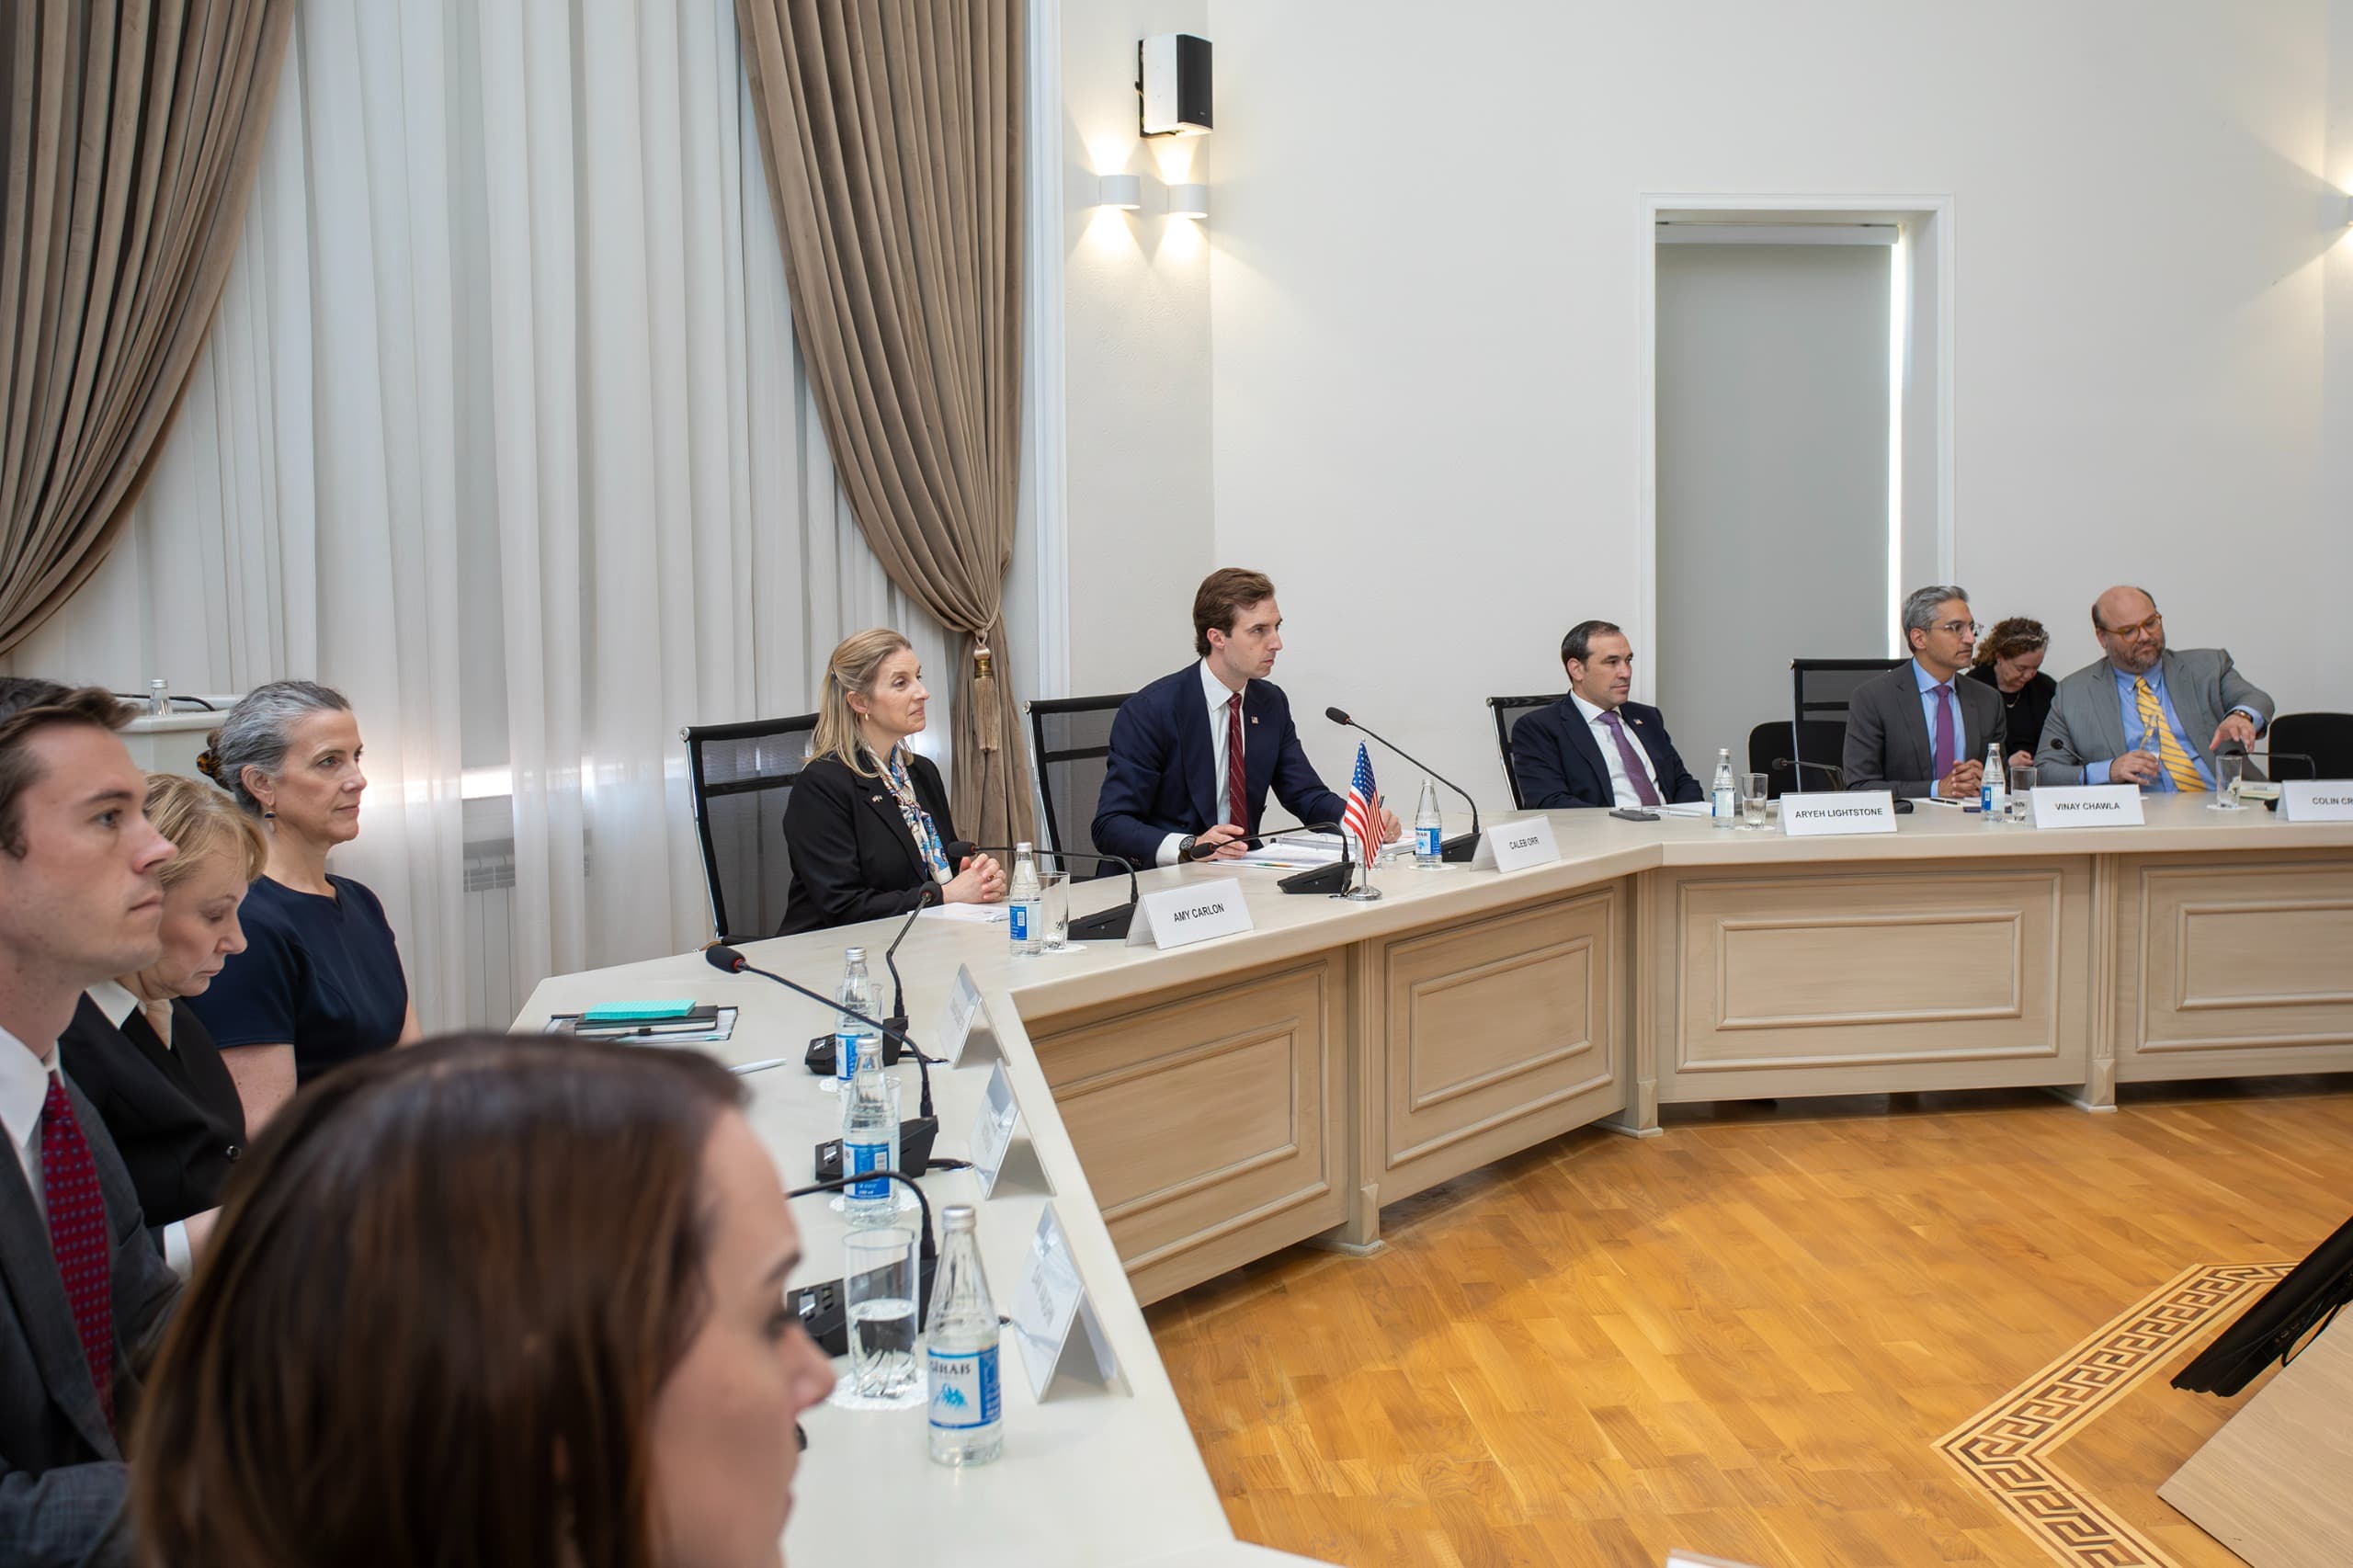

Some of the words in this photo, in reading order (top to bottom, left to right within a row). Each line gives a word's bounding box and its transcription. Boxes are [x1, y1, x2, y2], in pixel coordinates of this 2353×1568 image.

[2054, 801, 2080, 811] VINAY
[2082, 801, 2120, 811] CHAWLA
[2312, 796, 2339, 805] COLIN
[1795, 810, 1825, 819] ARYEH
[1827, 807, 1883, 817] LIGHTSTONE
[1508, 838, 1528, 850] CALEB
[1527, 836, 1540, 846] ORR
[1174, 910, 1190, 923] AMY
[1191, 903, 1225, 919] CARLON
